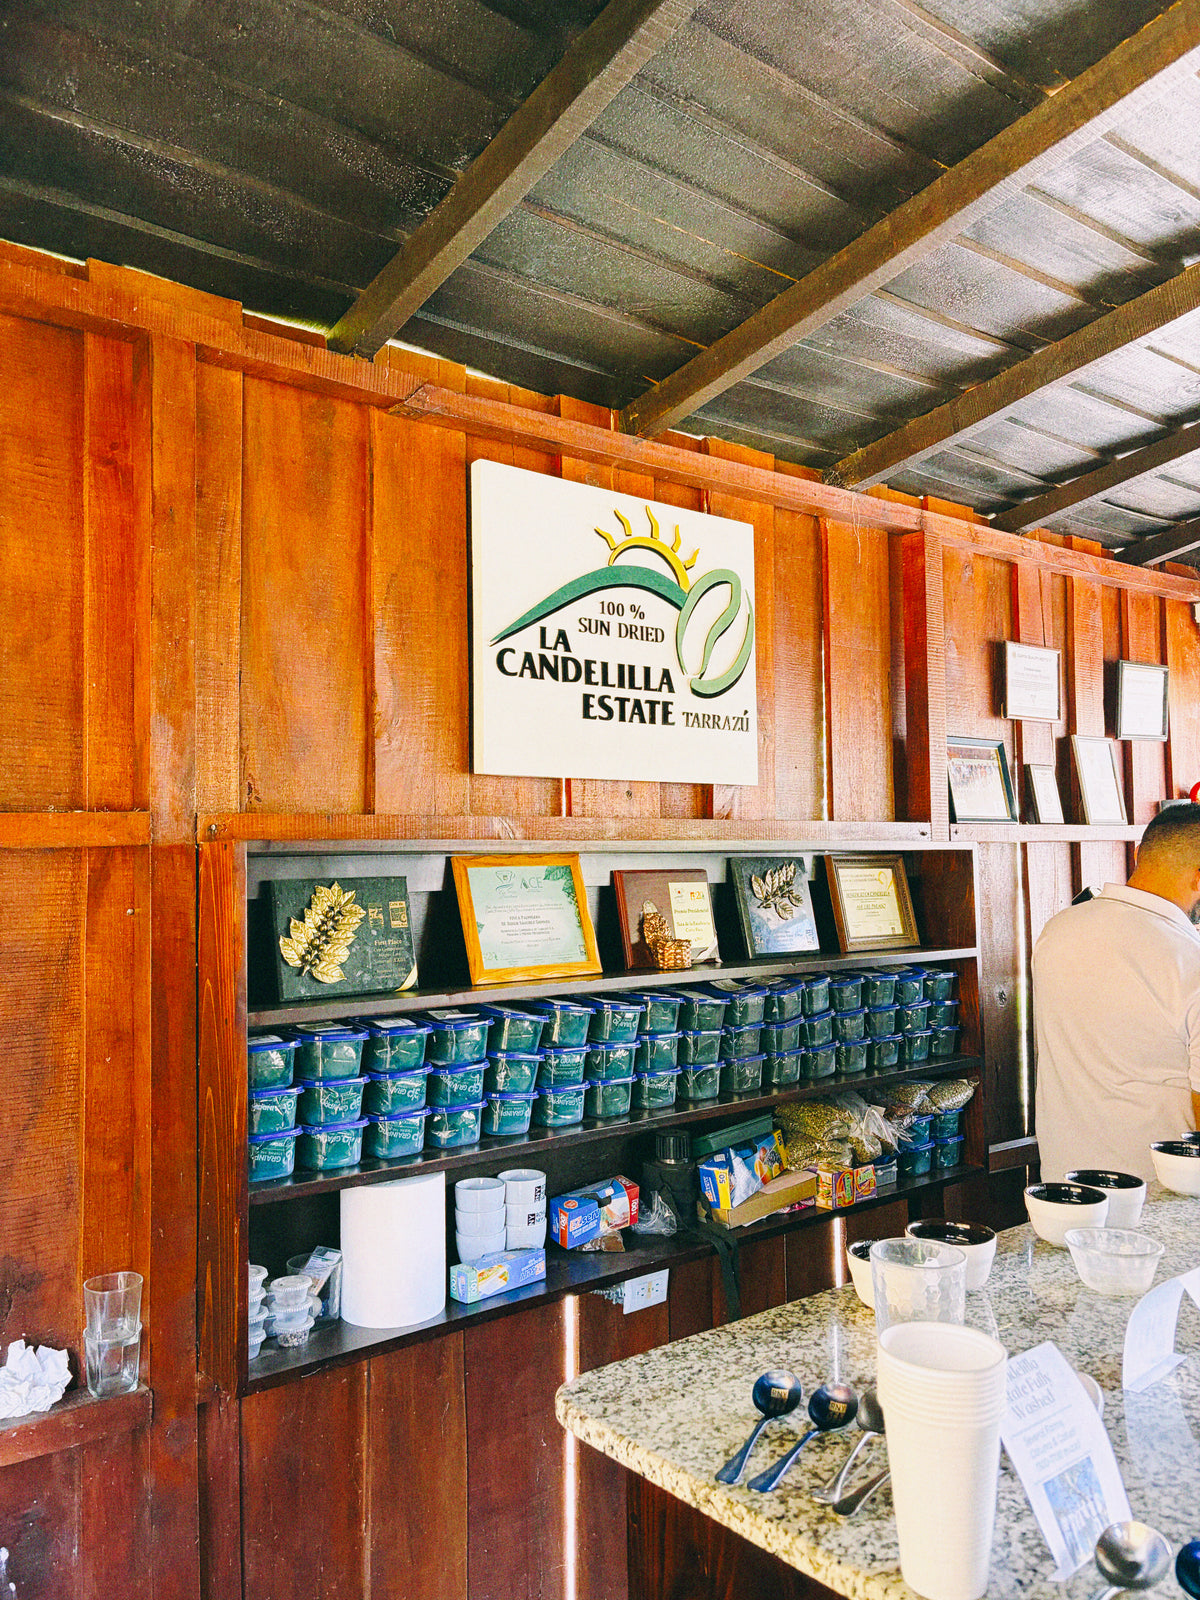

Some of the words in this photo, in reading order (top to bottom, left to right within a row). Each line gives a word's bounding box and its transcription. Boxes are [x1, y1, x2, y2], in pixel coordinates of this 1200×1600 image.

[599, 601, 626, 618] 100
[630, 604, 645, 620] %
[539, 626, 572, 653] LA
[578, 617, 611, 636] SUN
[618, 622, 665, 643] DRIED
[496, 648, 676, 694] CANDELILLA
[582, 693, 676, 726] ESTATE
[682, 709, 750, 732] TARRAZÚ
